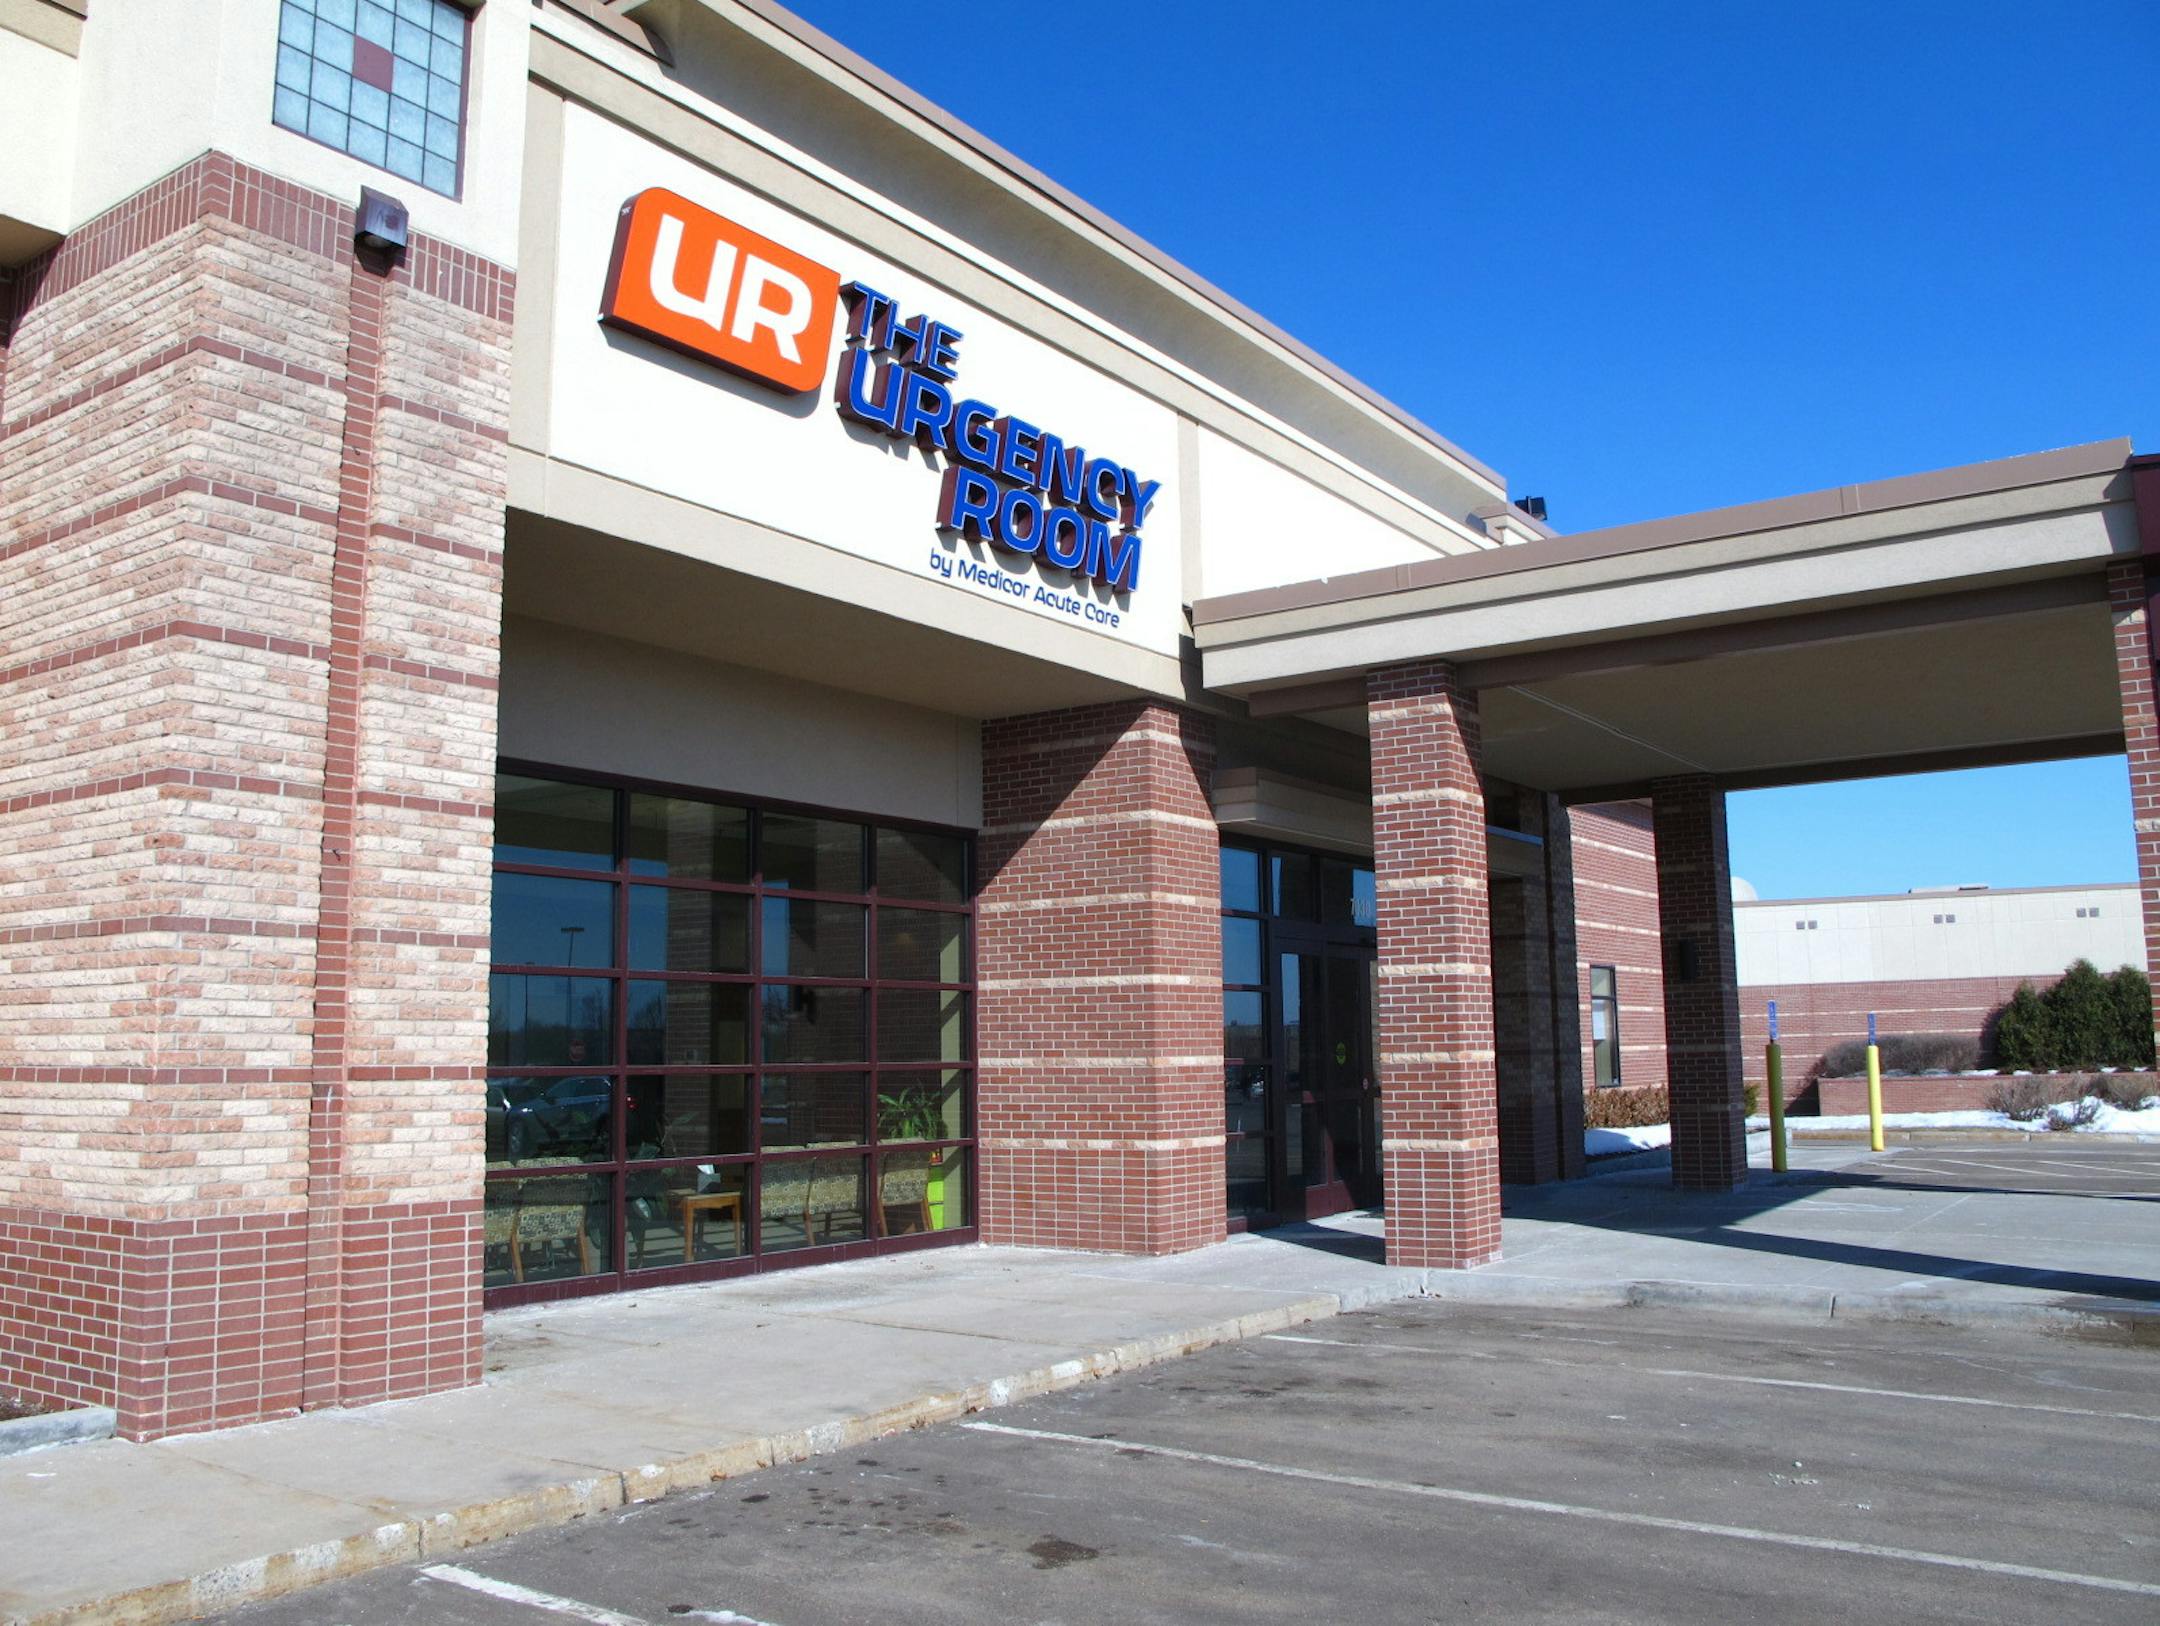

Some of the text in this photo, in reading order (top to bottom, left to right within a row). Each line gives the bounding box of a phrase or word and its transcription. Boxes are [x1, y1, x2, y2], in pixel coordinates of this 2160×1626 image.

[648, 212, 813, 364] UR
[852, 280, 965, 381] THE
[849, 346, 1163, 530] URGENCY
[929, 547, 1121, 629] by Medicor Acute Care
[951, 465, 1143, 593] ROOM
